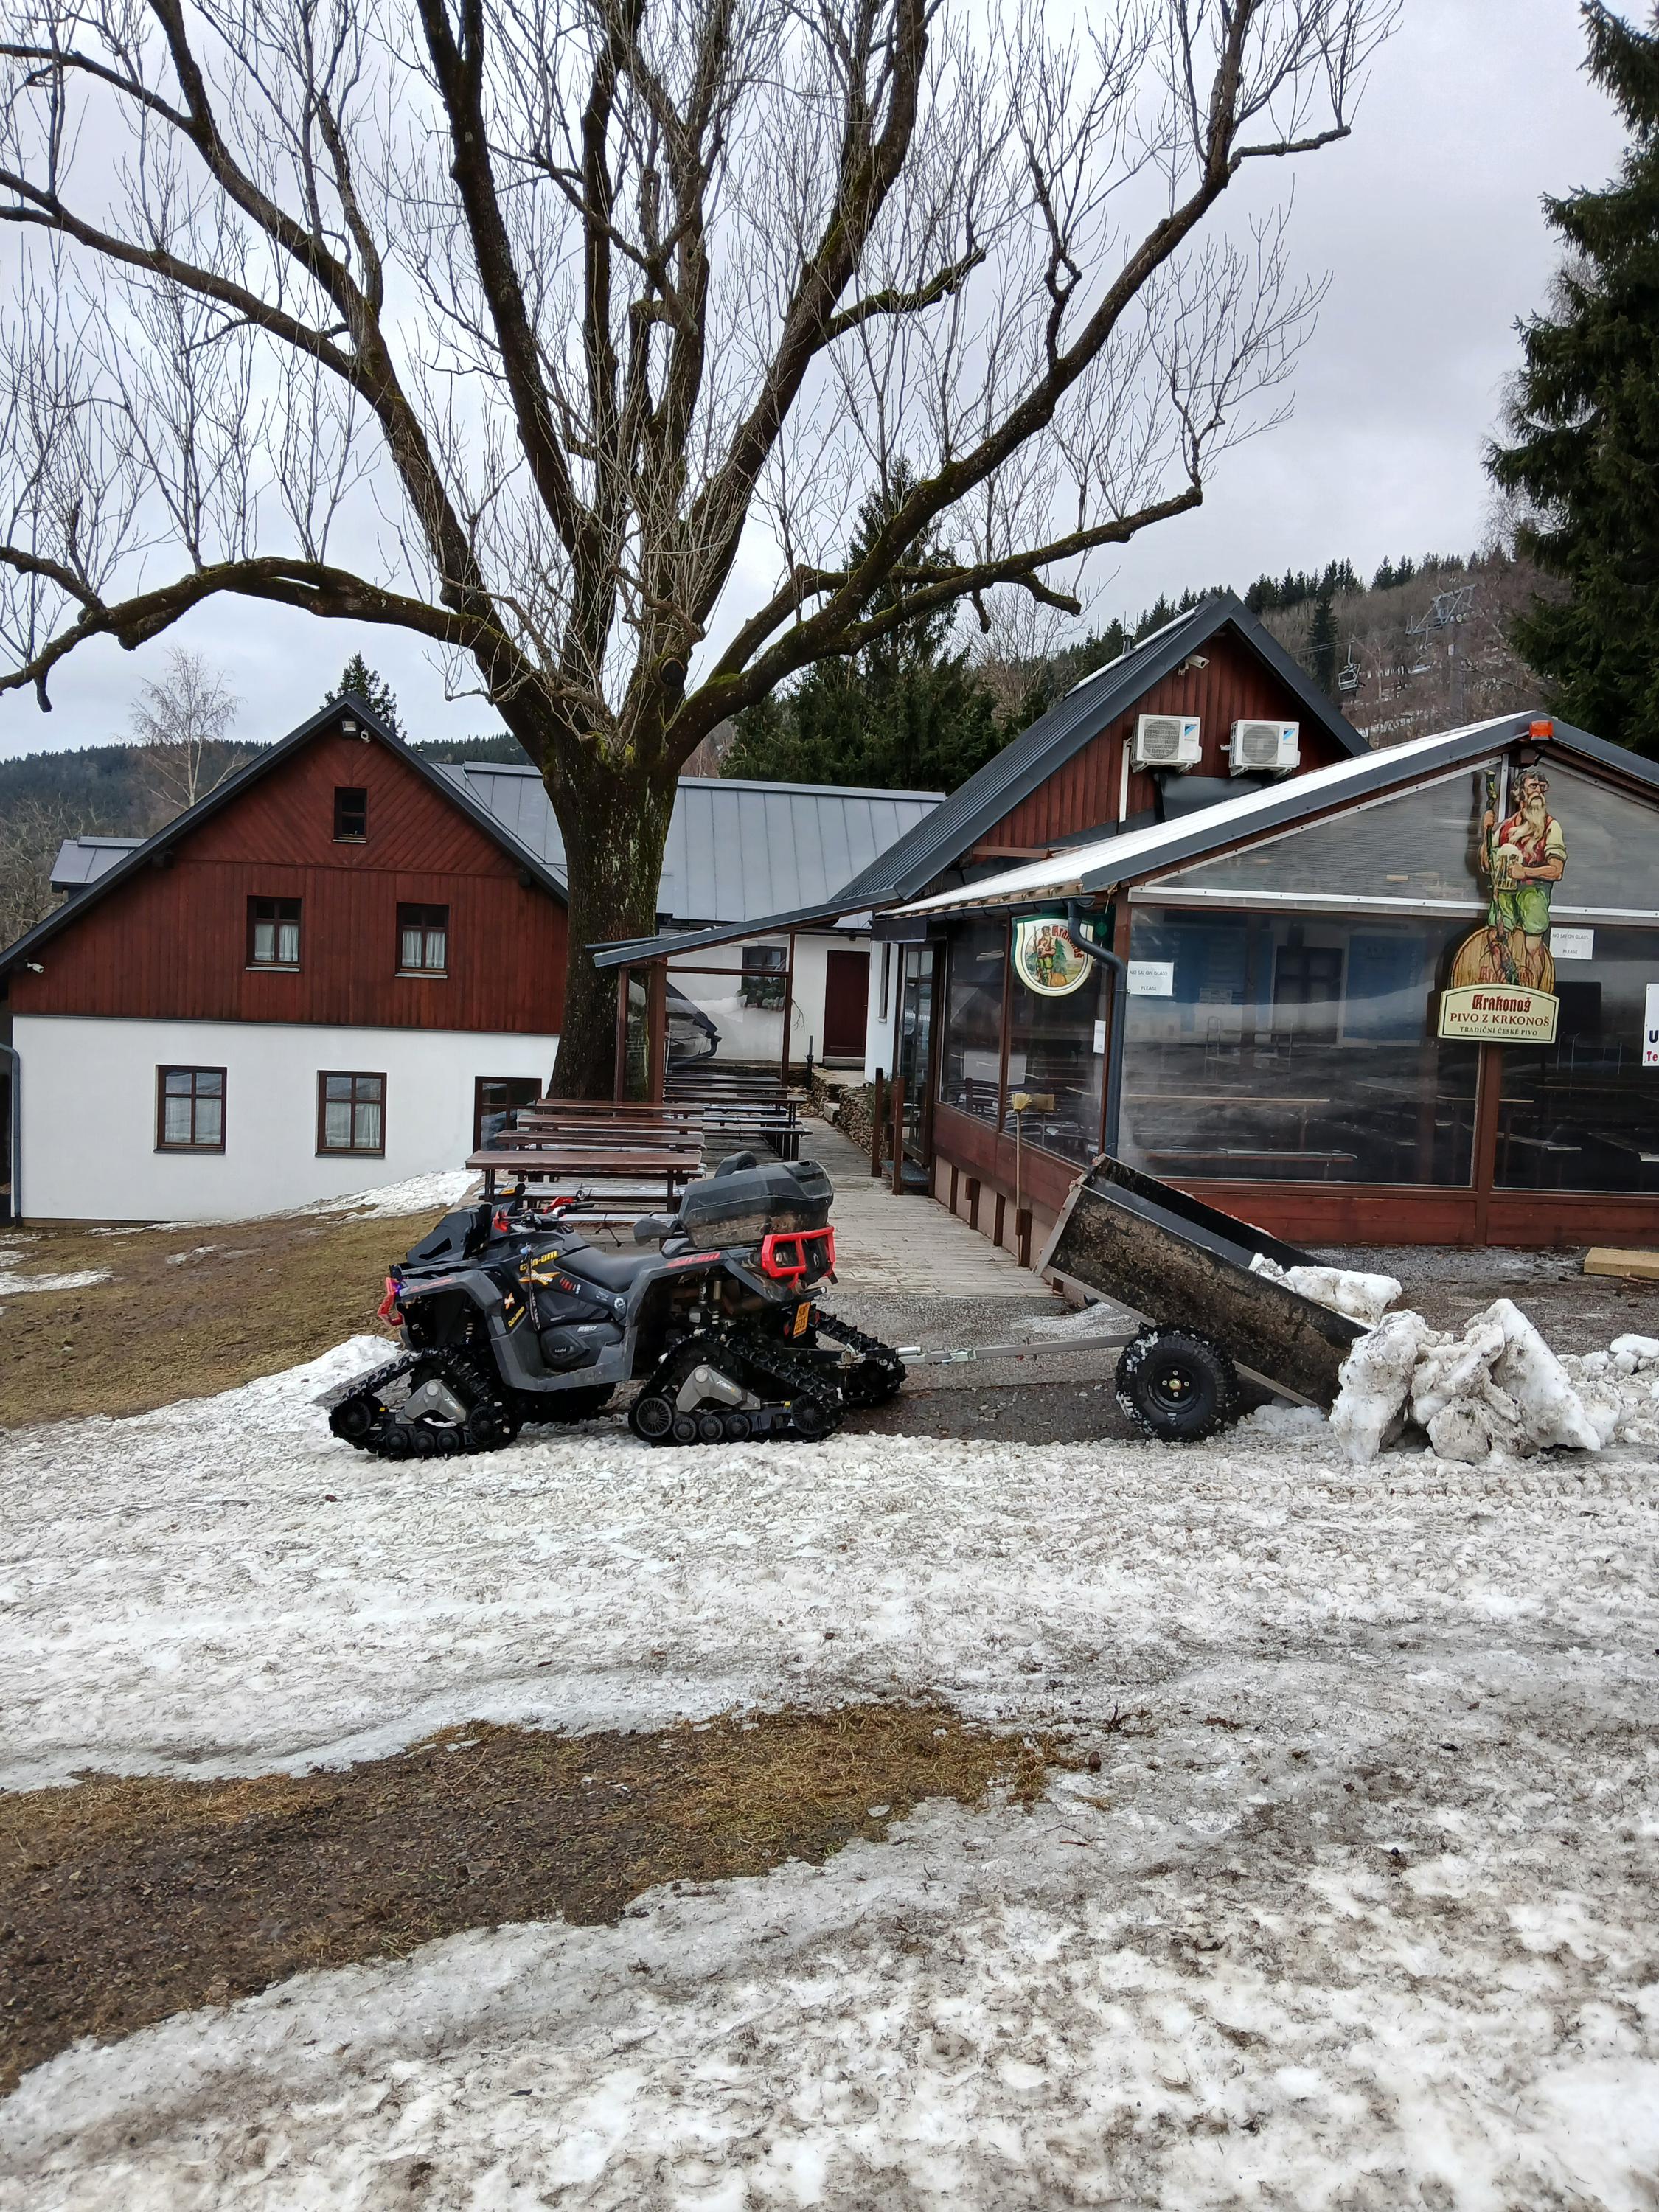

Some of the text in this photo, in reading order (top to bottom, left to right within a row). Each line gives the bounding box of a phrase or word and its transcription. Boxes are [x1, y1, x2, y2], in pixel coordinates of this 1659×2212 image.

[1472, 994, 1532, 1012] Krakonoš
[1450, 1012, 1550, 1026] PIVO Z KRKONOŠ
[1460, 1026, 1496, 1034] TRADIČNÍ
[1498, 1026, 1520, 1035] ČESKÉ
[519, 1250, 558, 1272] cn-am
